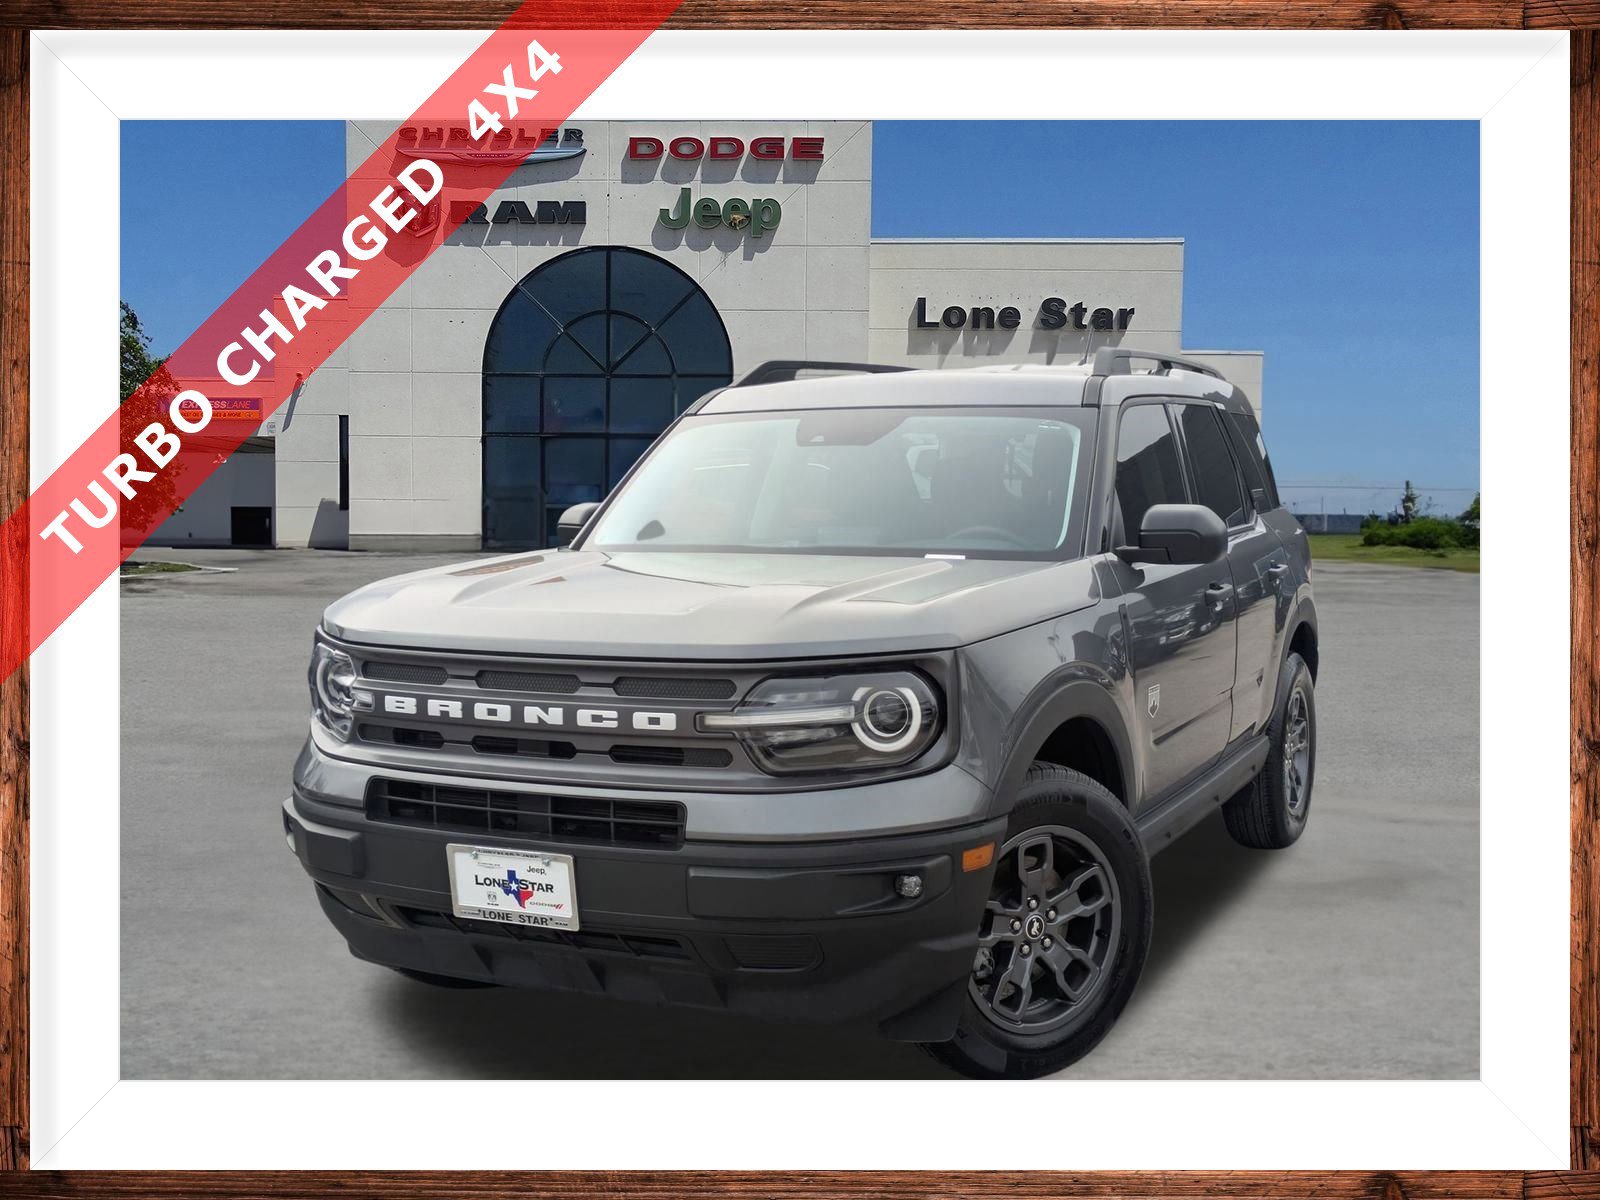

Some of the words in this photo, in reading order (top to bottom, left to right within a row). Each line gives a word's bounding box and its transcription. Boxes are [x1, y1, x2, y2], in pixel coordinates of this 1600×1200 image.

[399, 127, 584, 142] CHRSLER
[629, 137, 825, 160] DODGE
[450, 201, 586, 224] RAM
[659, 187, 782, 239] Jeep
[917, 297, 1021, 329] Lone
[1040, 297, 1135, 330] Star
[384, 695, 677, 731] BRONCO
[527, 866, 545, 875] Jeep
[475, 875, 510, 889] LONE
[519, 879, 554, 893] STAR
